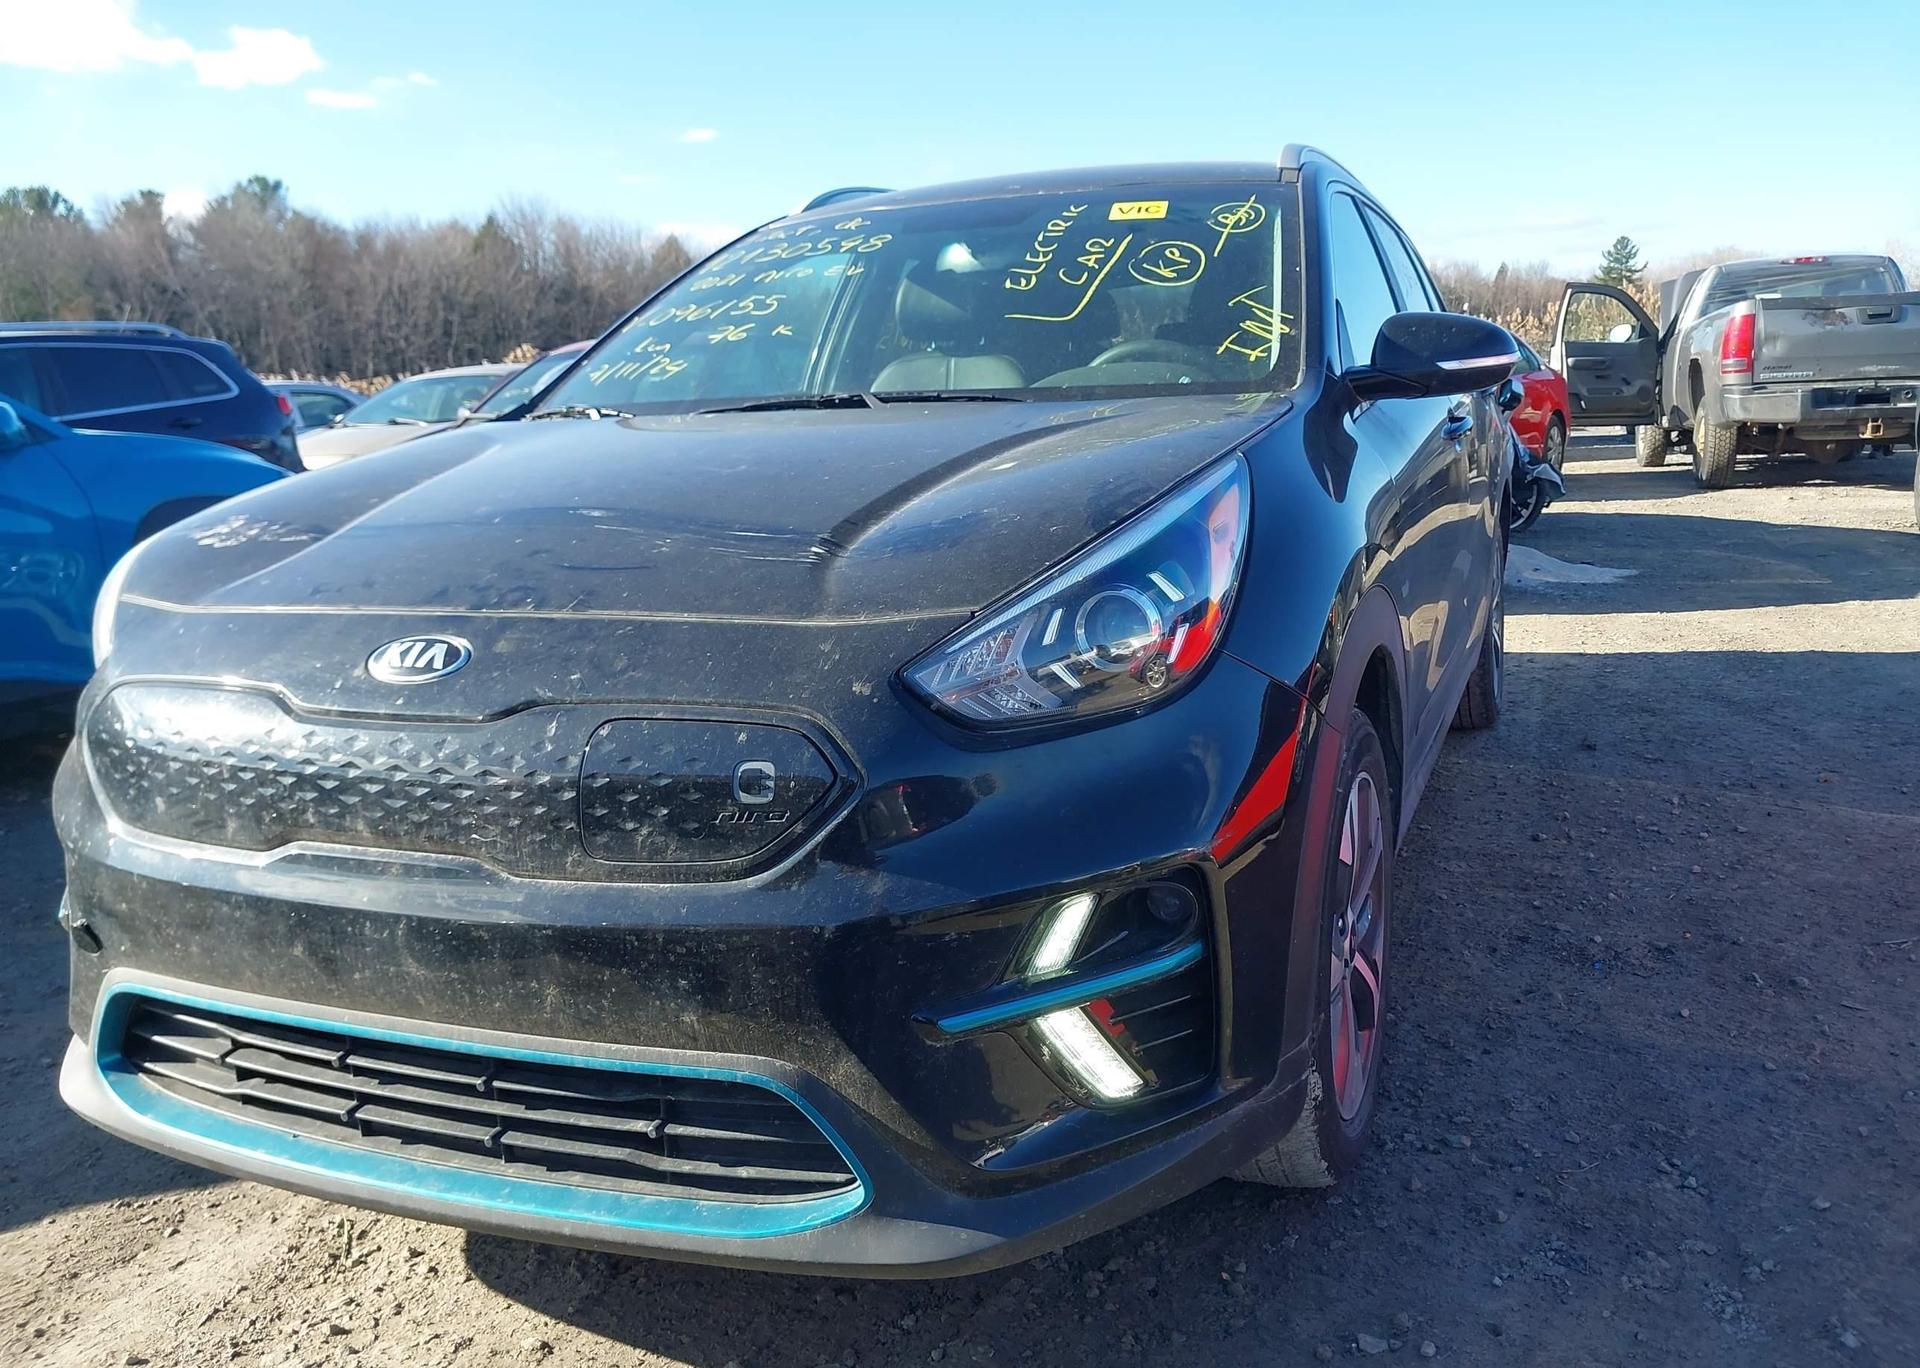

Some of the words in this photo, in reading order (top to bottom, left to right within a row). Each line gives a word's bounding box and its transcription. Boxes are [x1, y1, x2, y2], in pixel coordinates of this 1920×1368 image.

[1117, 204, 1162, 216] VIC
[1058, 237, 1115, 285] CAR
[1142, 247, 1191, 278] KP
[379, 640, 449, 670] KIA
